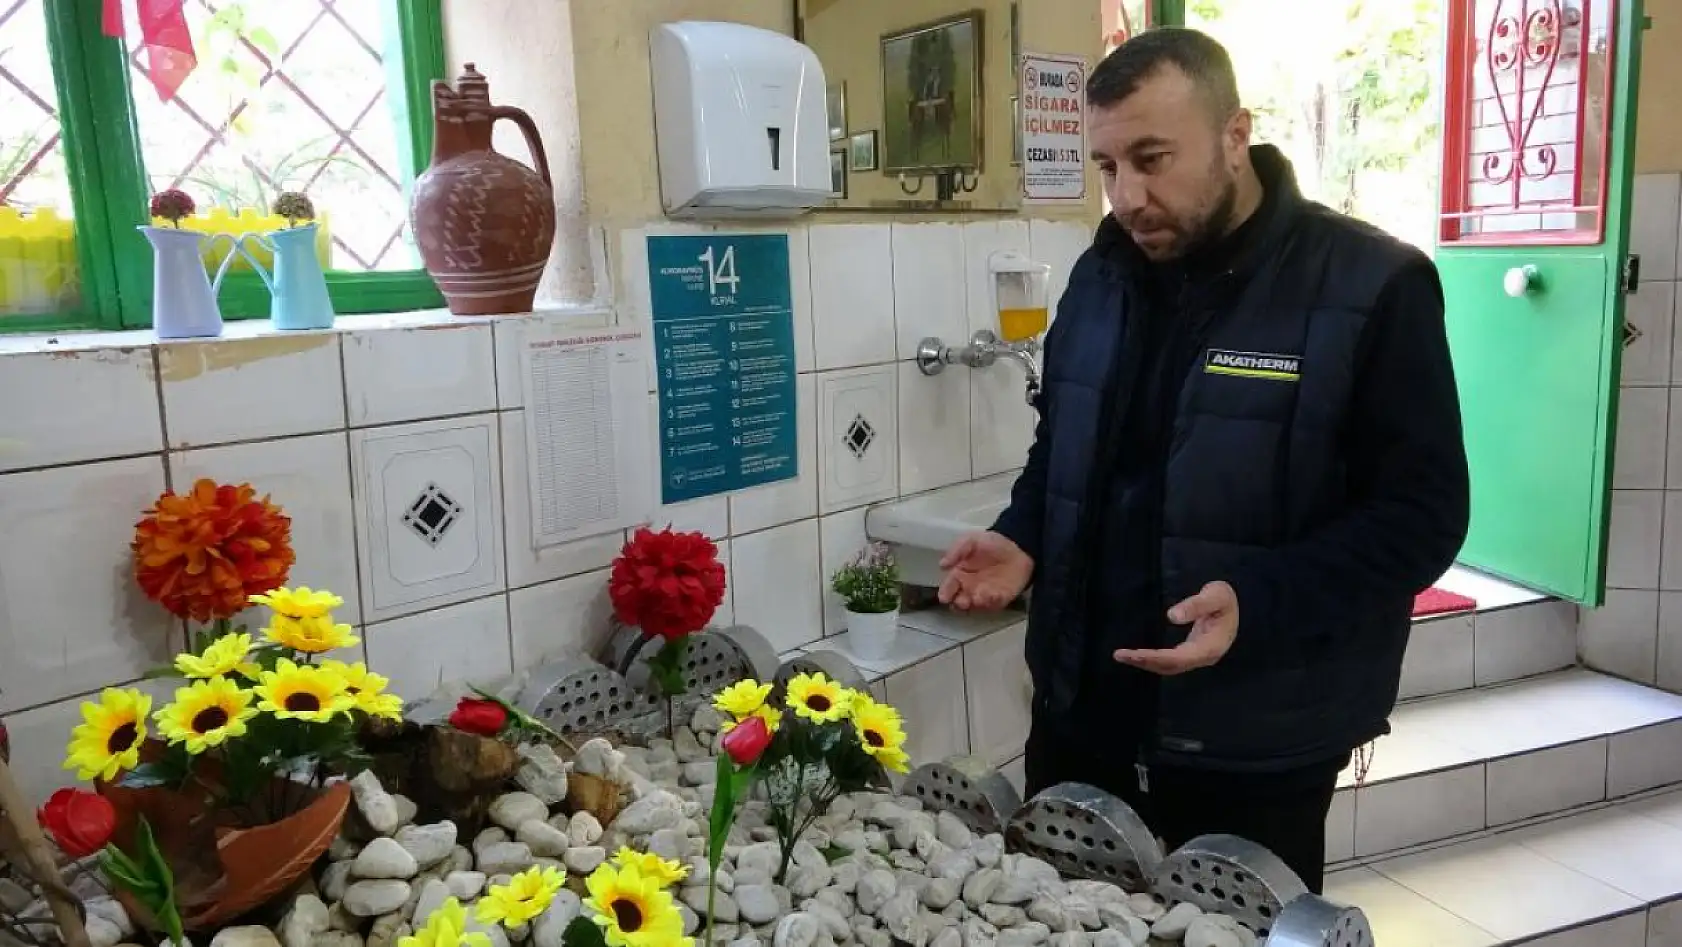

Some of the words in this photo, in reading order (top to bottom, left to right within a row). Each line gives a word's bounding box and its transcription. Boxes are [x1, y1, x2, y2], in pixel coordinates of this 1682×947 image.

[1040, 72, 1064, 88] BURADA
[1025, 93, 1079, 114] SİGARA
[1025, 114, 1079, 137] İÇİLMEZ
[698, 245, 740, 294] 14
[1212, 353, 1299, 371] AKATHERM
